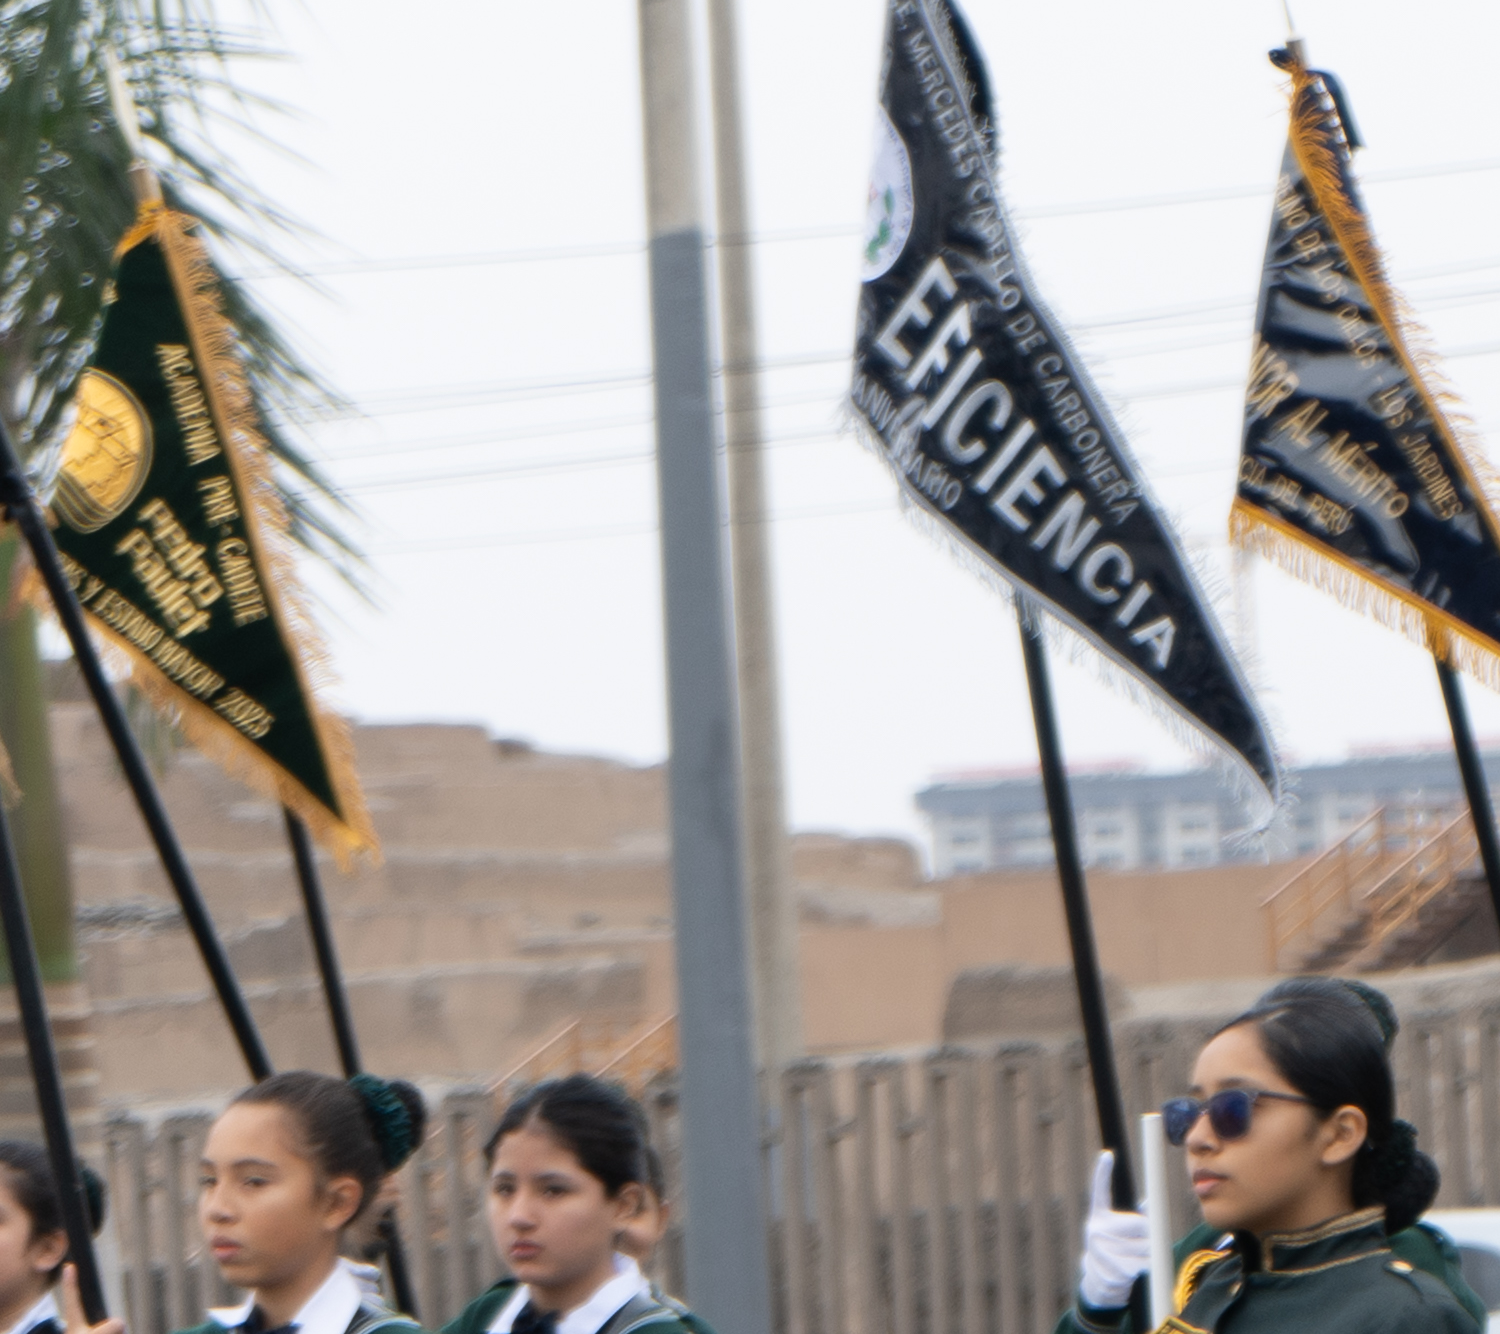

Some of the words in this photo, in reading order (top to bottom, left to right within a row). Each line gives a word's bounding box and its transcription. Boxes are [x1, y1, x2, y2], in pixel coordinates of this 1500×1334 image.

[909, 28, 984, 180] MERCEDES
[1004, 314, 1048, 357] DE
[1036, 351, 1140, 526] CARBONERA
[872, 256, 1178, 670] EFICIENCIA
[1272, 475, 1303, 511] DEL
[1304, 493, 1357, 537] PERÚ
[1275, 398, 1330, 448] AL
[1317, 430, 1410, 519] MÉRITO
[1379, 386, 1413, 430] LOS
[1401, 433, 1464, 521] JARDINES
[151, 635, 226, 701] MAYOR
